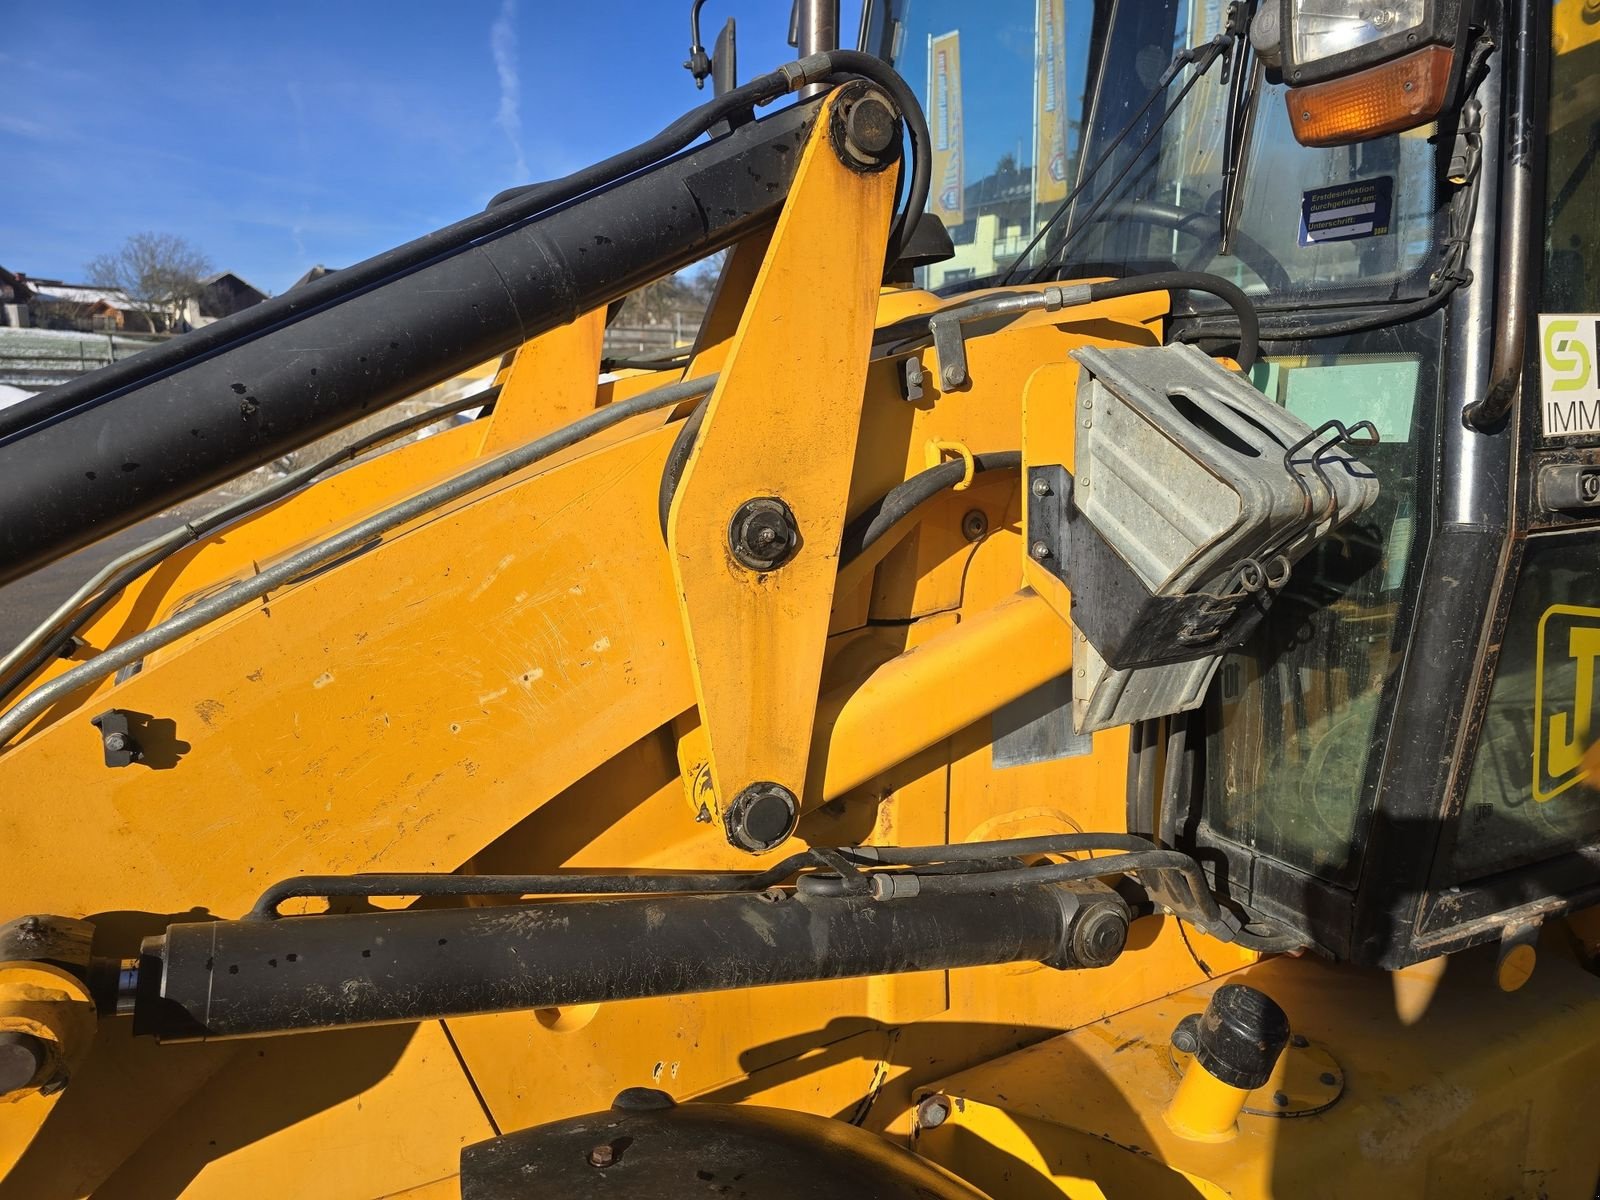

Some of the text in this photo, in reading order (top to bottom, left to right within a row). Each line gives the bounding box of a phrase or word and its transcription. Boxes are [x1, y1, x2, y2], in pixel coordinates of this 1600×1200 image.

[1311, 185, 1375, 202] Erstdesinfektion
[1310, 194, 1376, 212] durchgeführt am:
[1308, 216, 1355, 231] Unterschrift:
